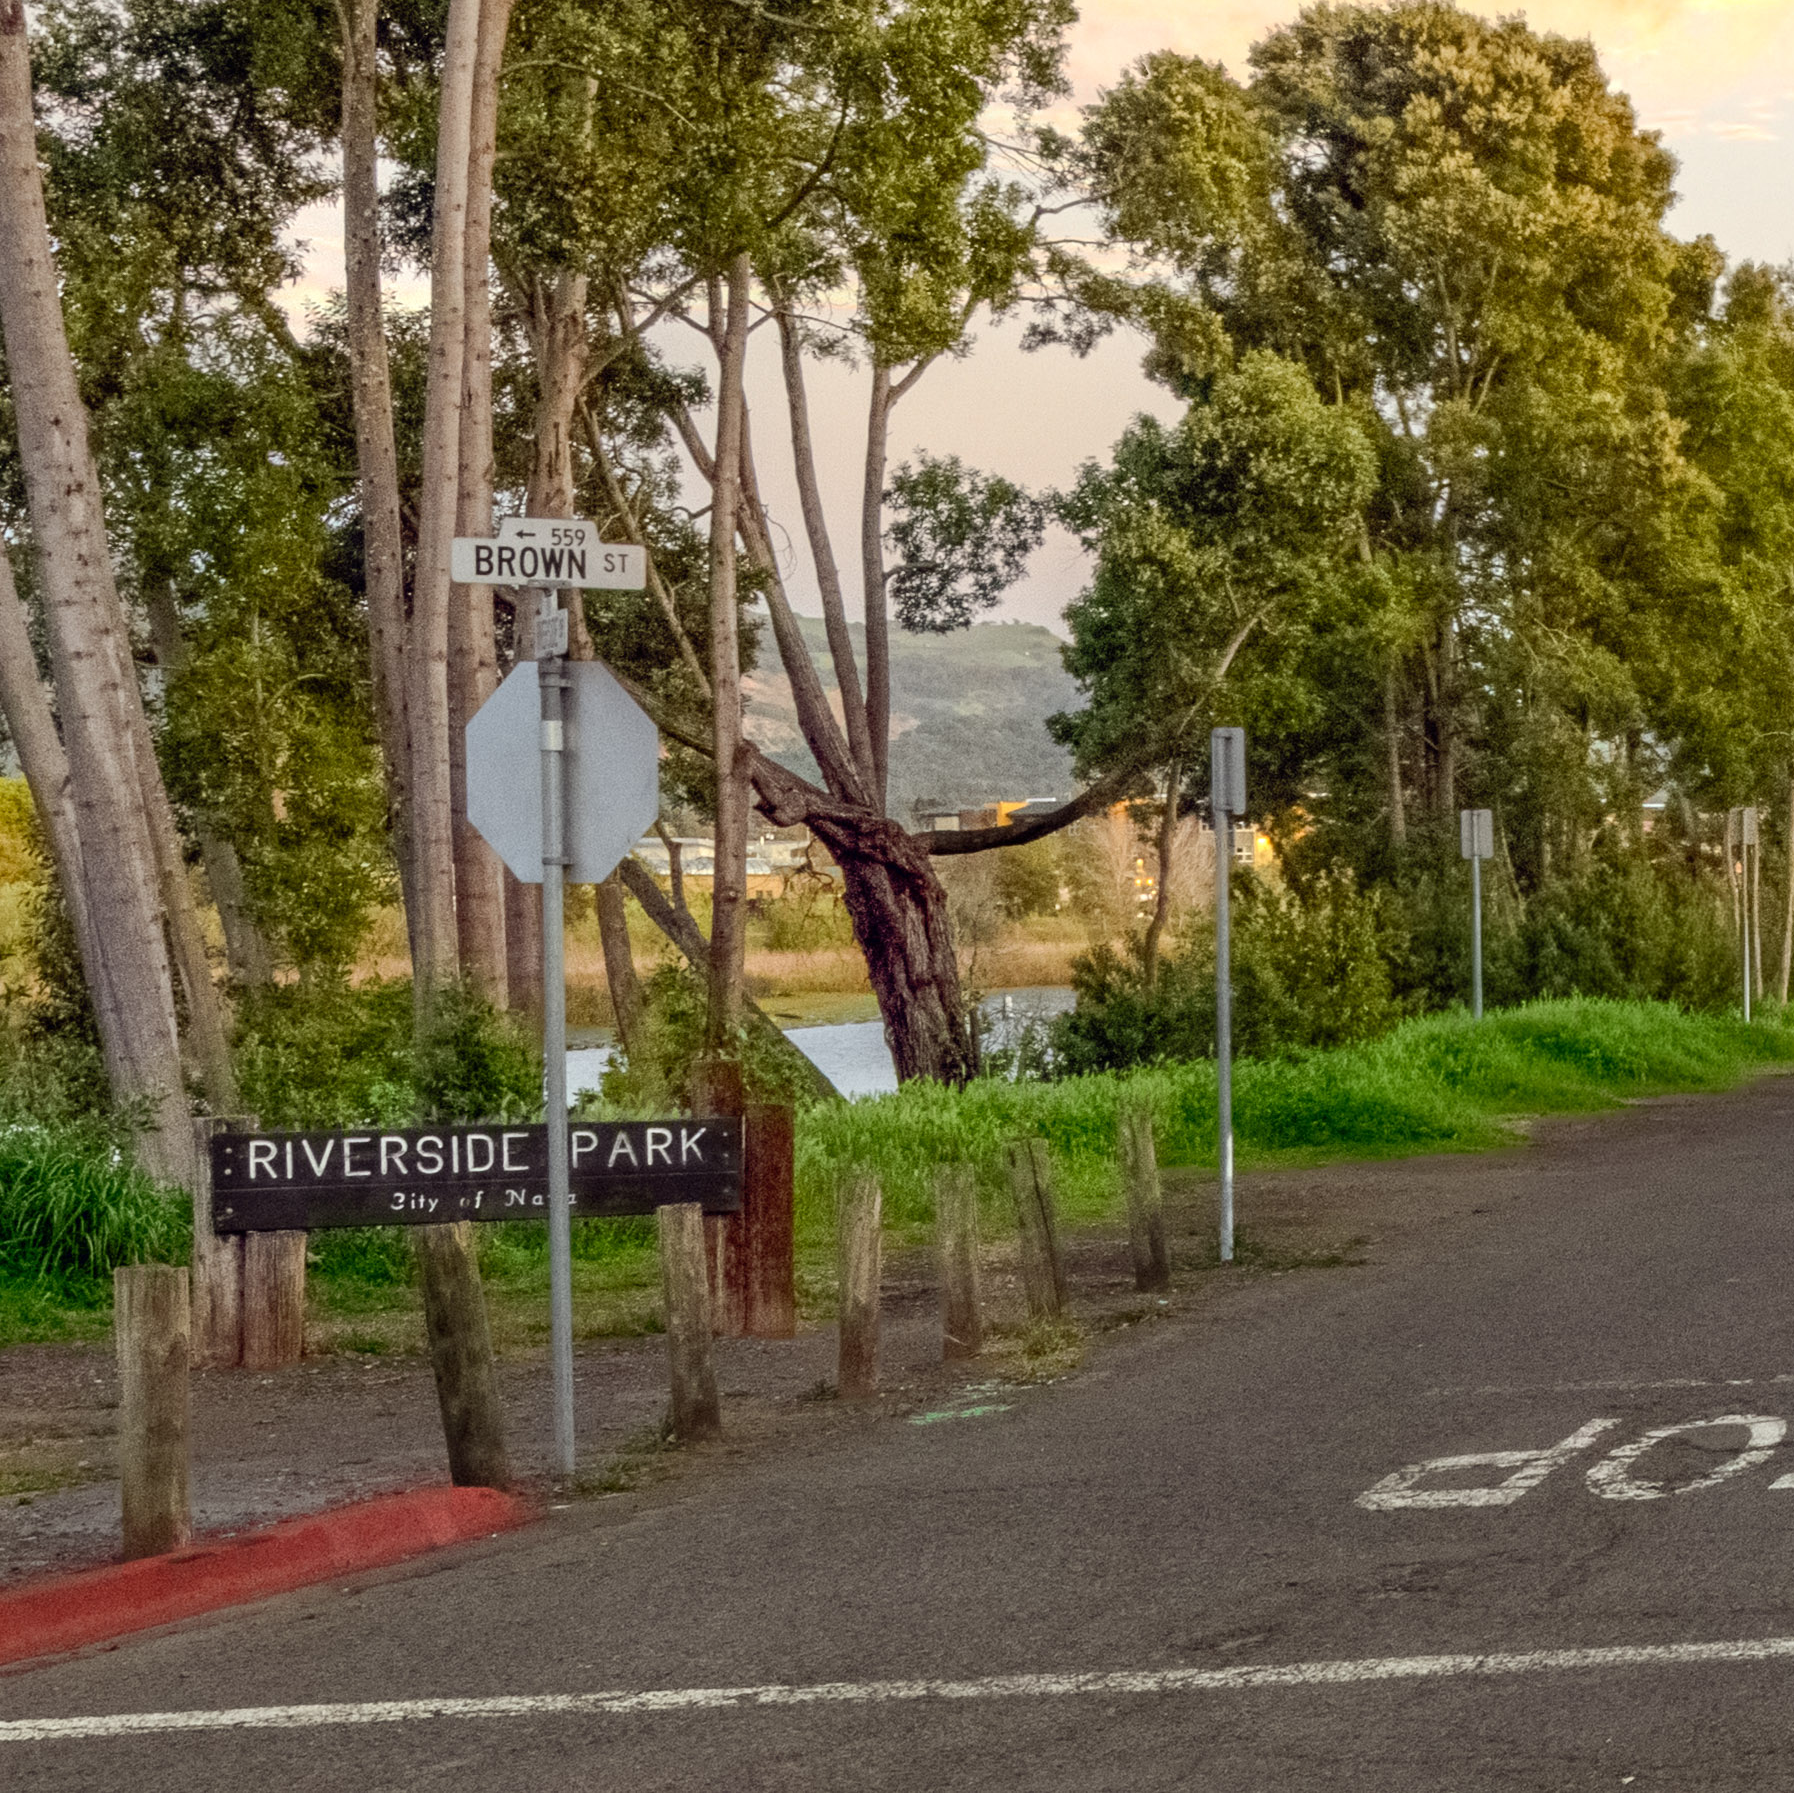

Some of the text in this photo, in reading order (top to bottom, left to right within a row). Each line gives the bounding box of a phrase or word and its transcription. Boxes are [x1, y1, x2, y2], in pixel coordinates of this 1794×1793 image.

[551, 528, 586, 547] 559
[475, 545, 629, 579] BROWN ST
[248, 1127, 708, 1179] RIVERSIDE PARK
[390, 1192, 439, 1213] City
[459, 1190, 484, 1209] of
